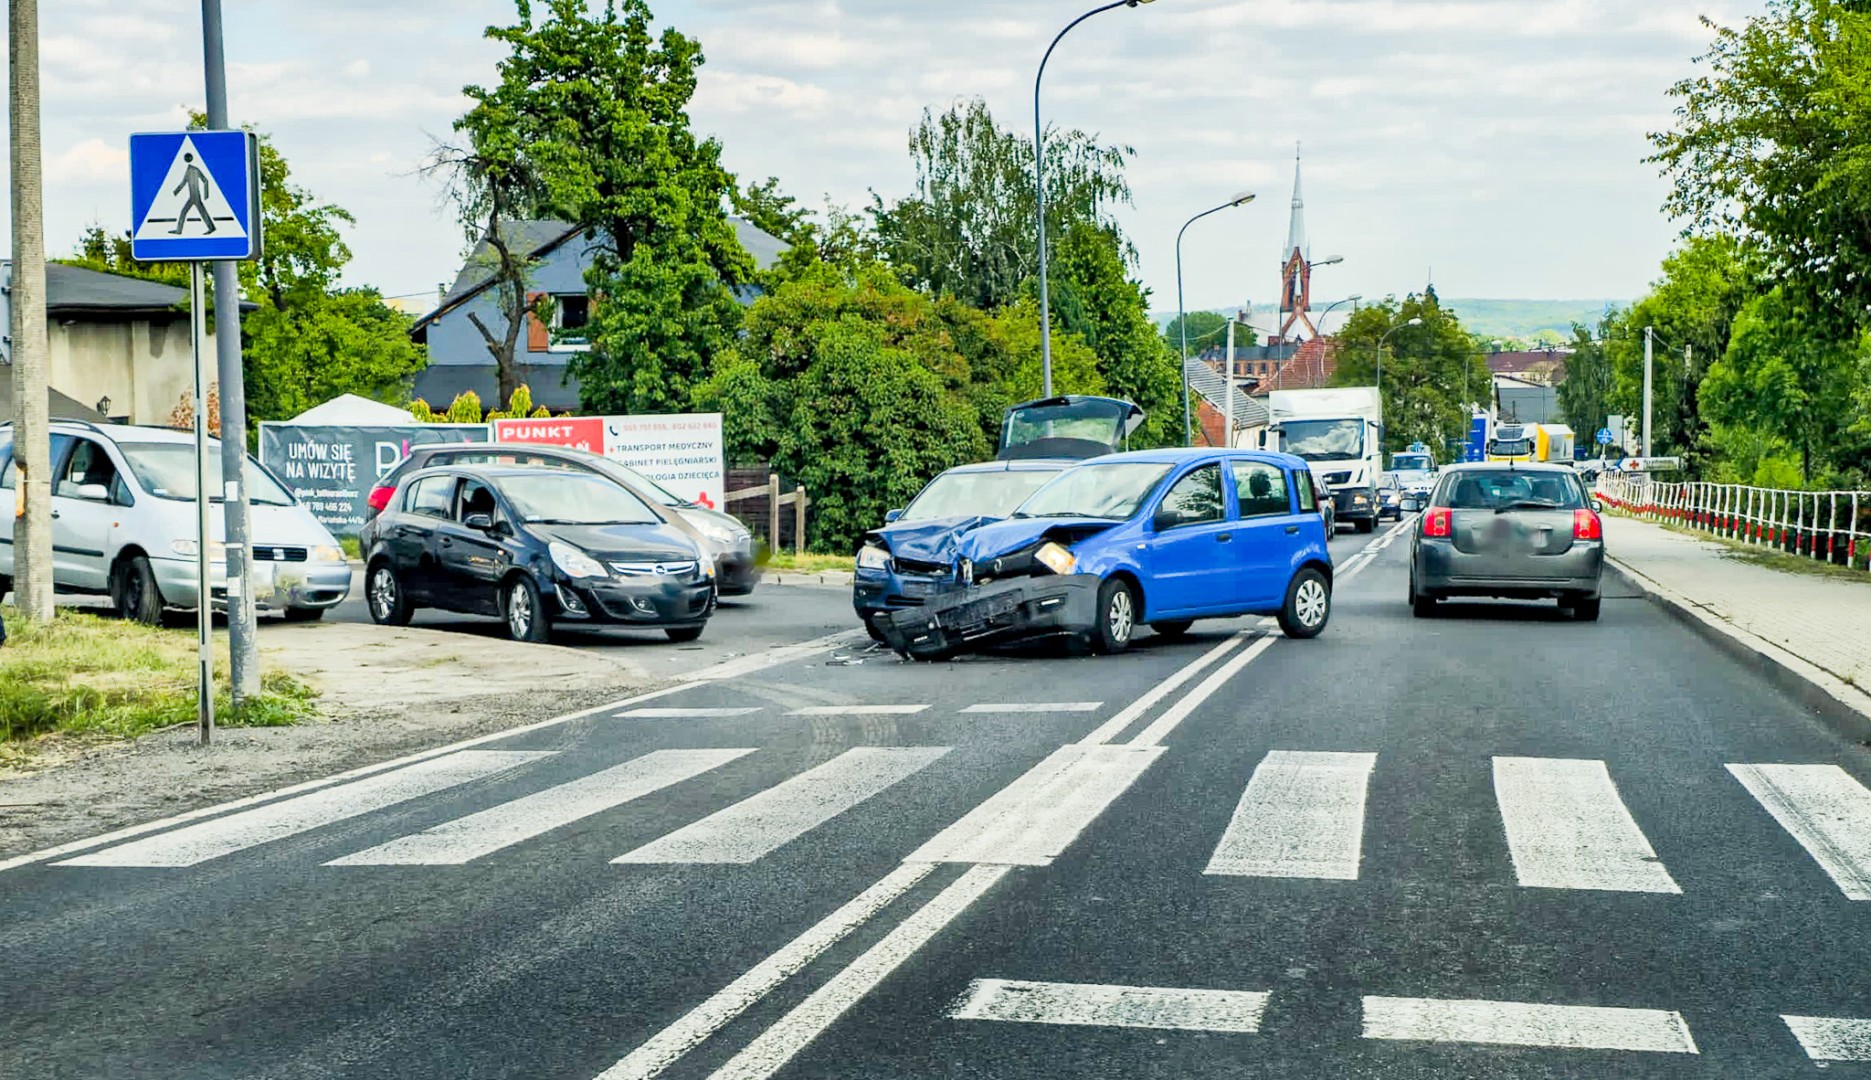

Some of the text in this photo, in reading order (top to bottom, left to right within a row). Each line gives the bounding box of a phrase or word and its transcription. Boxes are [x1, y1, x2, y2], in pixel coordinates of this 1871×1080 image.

[502, 425, 574, 439] PUNKT
[288, 440, 353, 464] UMÓW SIĘ
[616, 442, 713, 452] TRANSPORT MEDYCZNY
[655, 456, 717, 466] PIELĘGNIARSKI
[286, 461, 356, 483] NA WIZYTĘ
[678, 471, 720, 481] DZIECIĘCA
